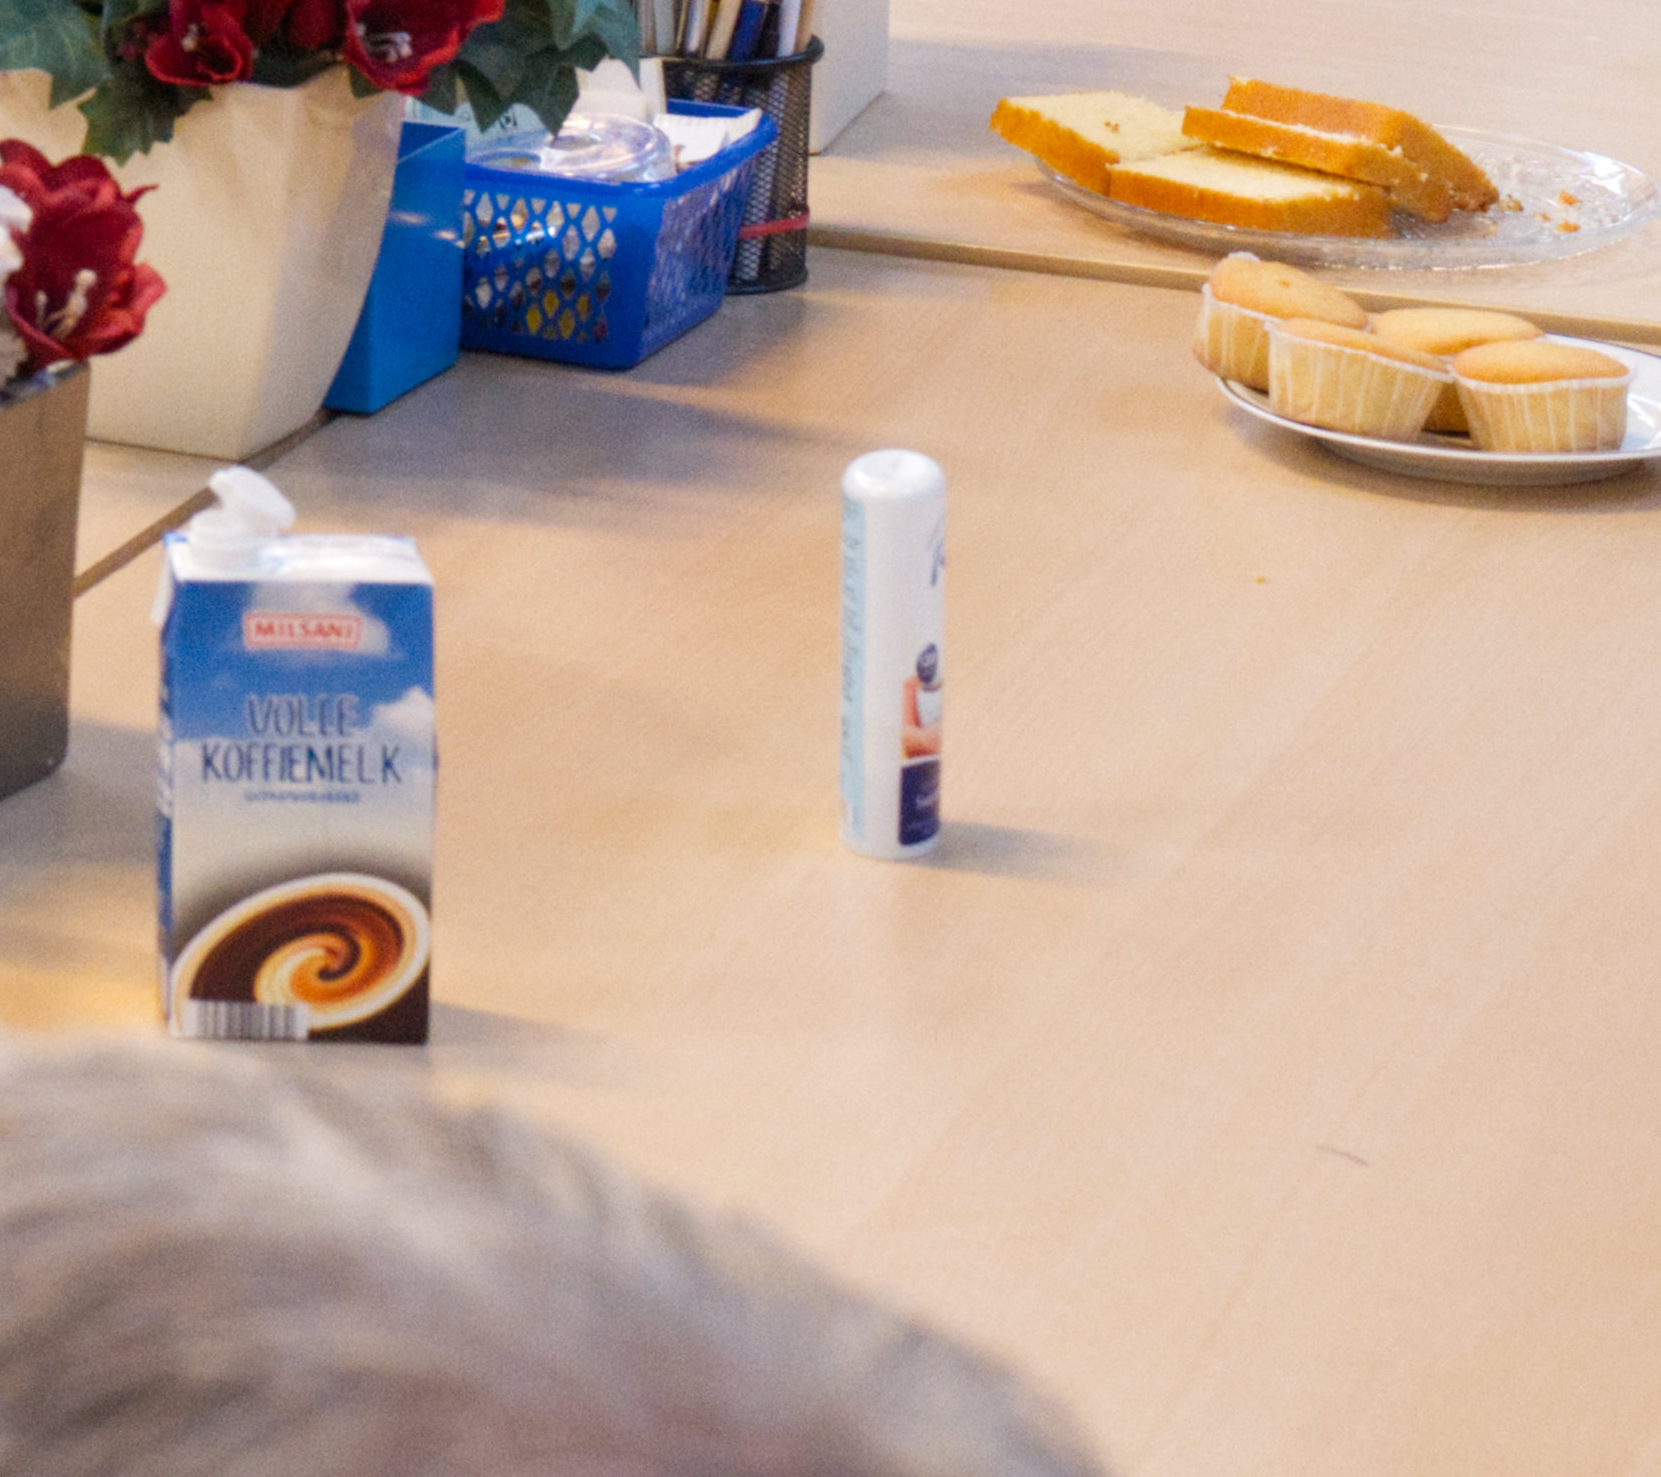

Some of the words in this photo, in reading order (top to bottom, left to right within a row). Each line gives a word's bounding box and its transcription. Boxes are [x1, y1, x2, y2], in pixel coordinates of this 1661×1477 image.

[254, 619, 356, 641] MILSANI
[246, 693, 361, 738] VOLLE
[201, 743, 404, 785] KOFFIEMELK
